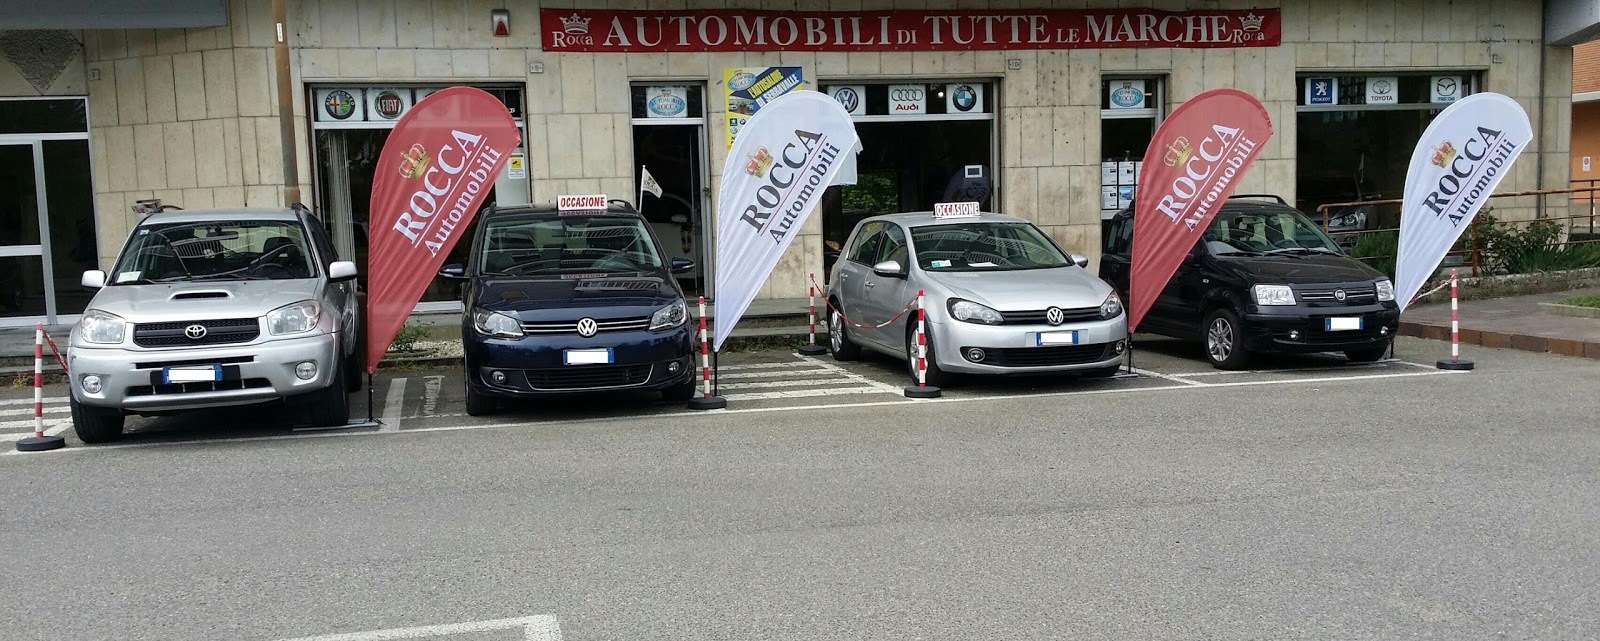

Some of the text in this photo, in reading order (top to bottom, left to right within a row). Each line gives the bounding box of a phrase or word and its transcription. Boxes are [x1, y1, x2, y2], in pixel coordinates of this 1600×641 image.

[602, 14, 1232, 46] AUTOMOBILI DI TUTTE LE MARCHE
[381, 100, 398, 112] FIAT
[763, 73, 800, 103] SERRAVALLE
[896, 103, 919, 111] Audi
[392, 129, 482, 245] ROCCA
[424, 145, 502, 258] Automobili
[560, 196, 605, 208] OCCASIONE
[739, 128, 823, 234] ROCCA
[769, 142, 841, 245] Automobili
[936, 203, 979, 216] OCCASIONE
[1155, 124, 1240, 223] ROCCA
[1183, 136, 1256, 233] Automobili
[1421, 126, 1502, 217] ROCCA
[1447, 139, 1517, 228] Automobili
